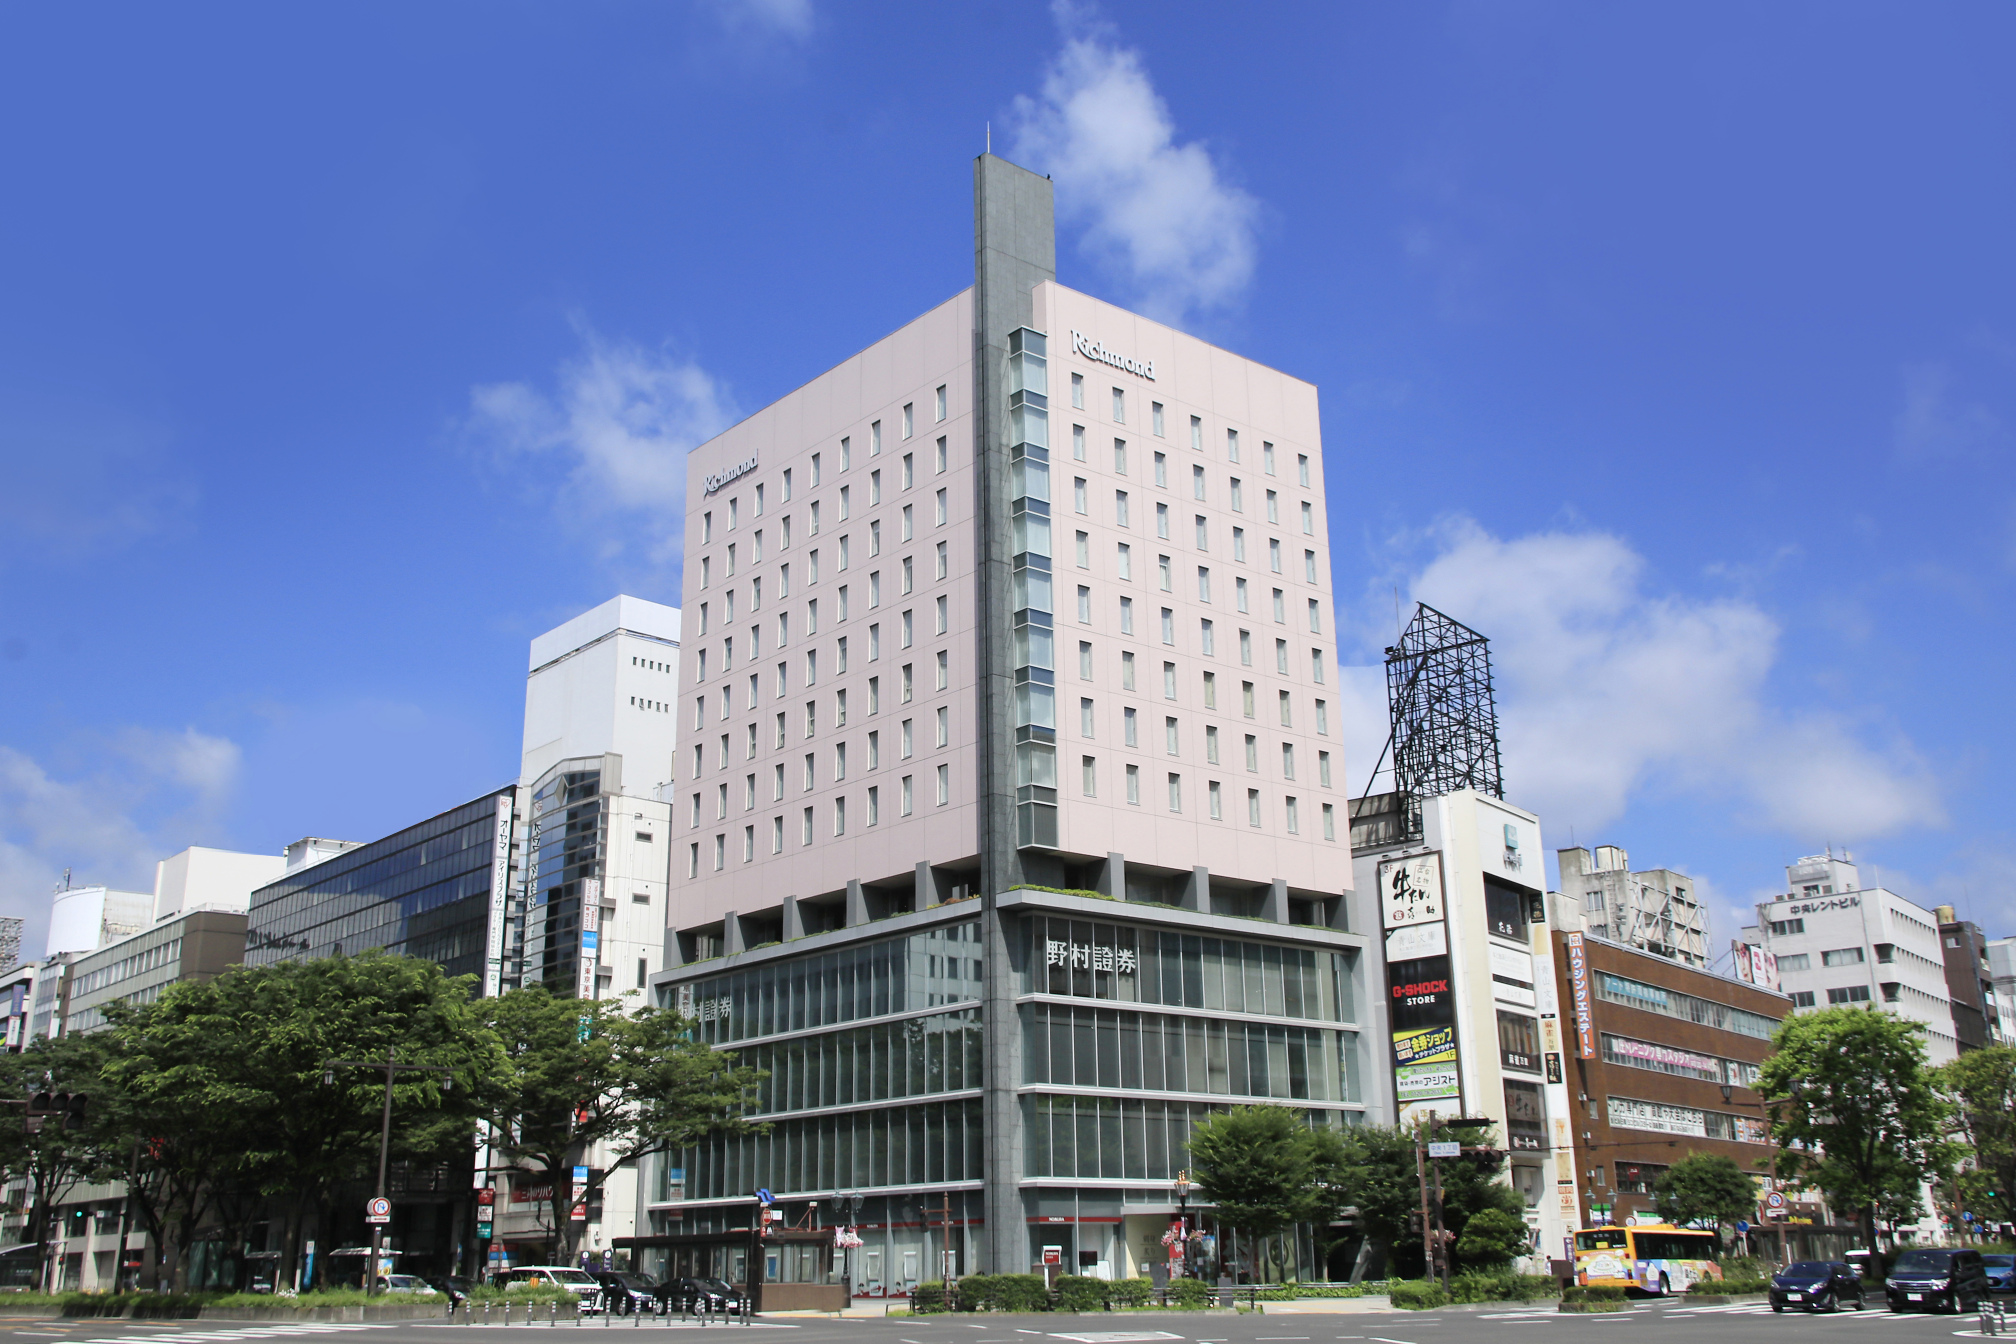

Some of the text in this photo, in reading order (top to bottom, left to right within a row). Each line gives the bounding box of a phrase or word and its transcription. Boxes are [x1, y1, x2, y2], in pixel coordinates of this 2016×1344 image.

[1070, 329, 1156, 382] Richmond
[703, 448, 759, 501] Richmond
[499, 820, 508, 851] オーヤマ
[1384, 865, 1393, 874] 3F
[1392, 867, 1431, 905] 牛たん
[1790, 897, 1860, 915] 中央レントビル
[1047, 939, 1137, 974] 野村證券
[1393, 980, 1448, 997] G-SHOCK
[1407, 995, 1435, 1005] STORE
[1571, 947, 1593, 1057] ハウジングエステート
[1411, 1027, 1452, 1053] 金券ショップ
[521, 1185, 554, 1199] 三井のリハウ
